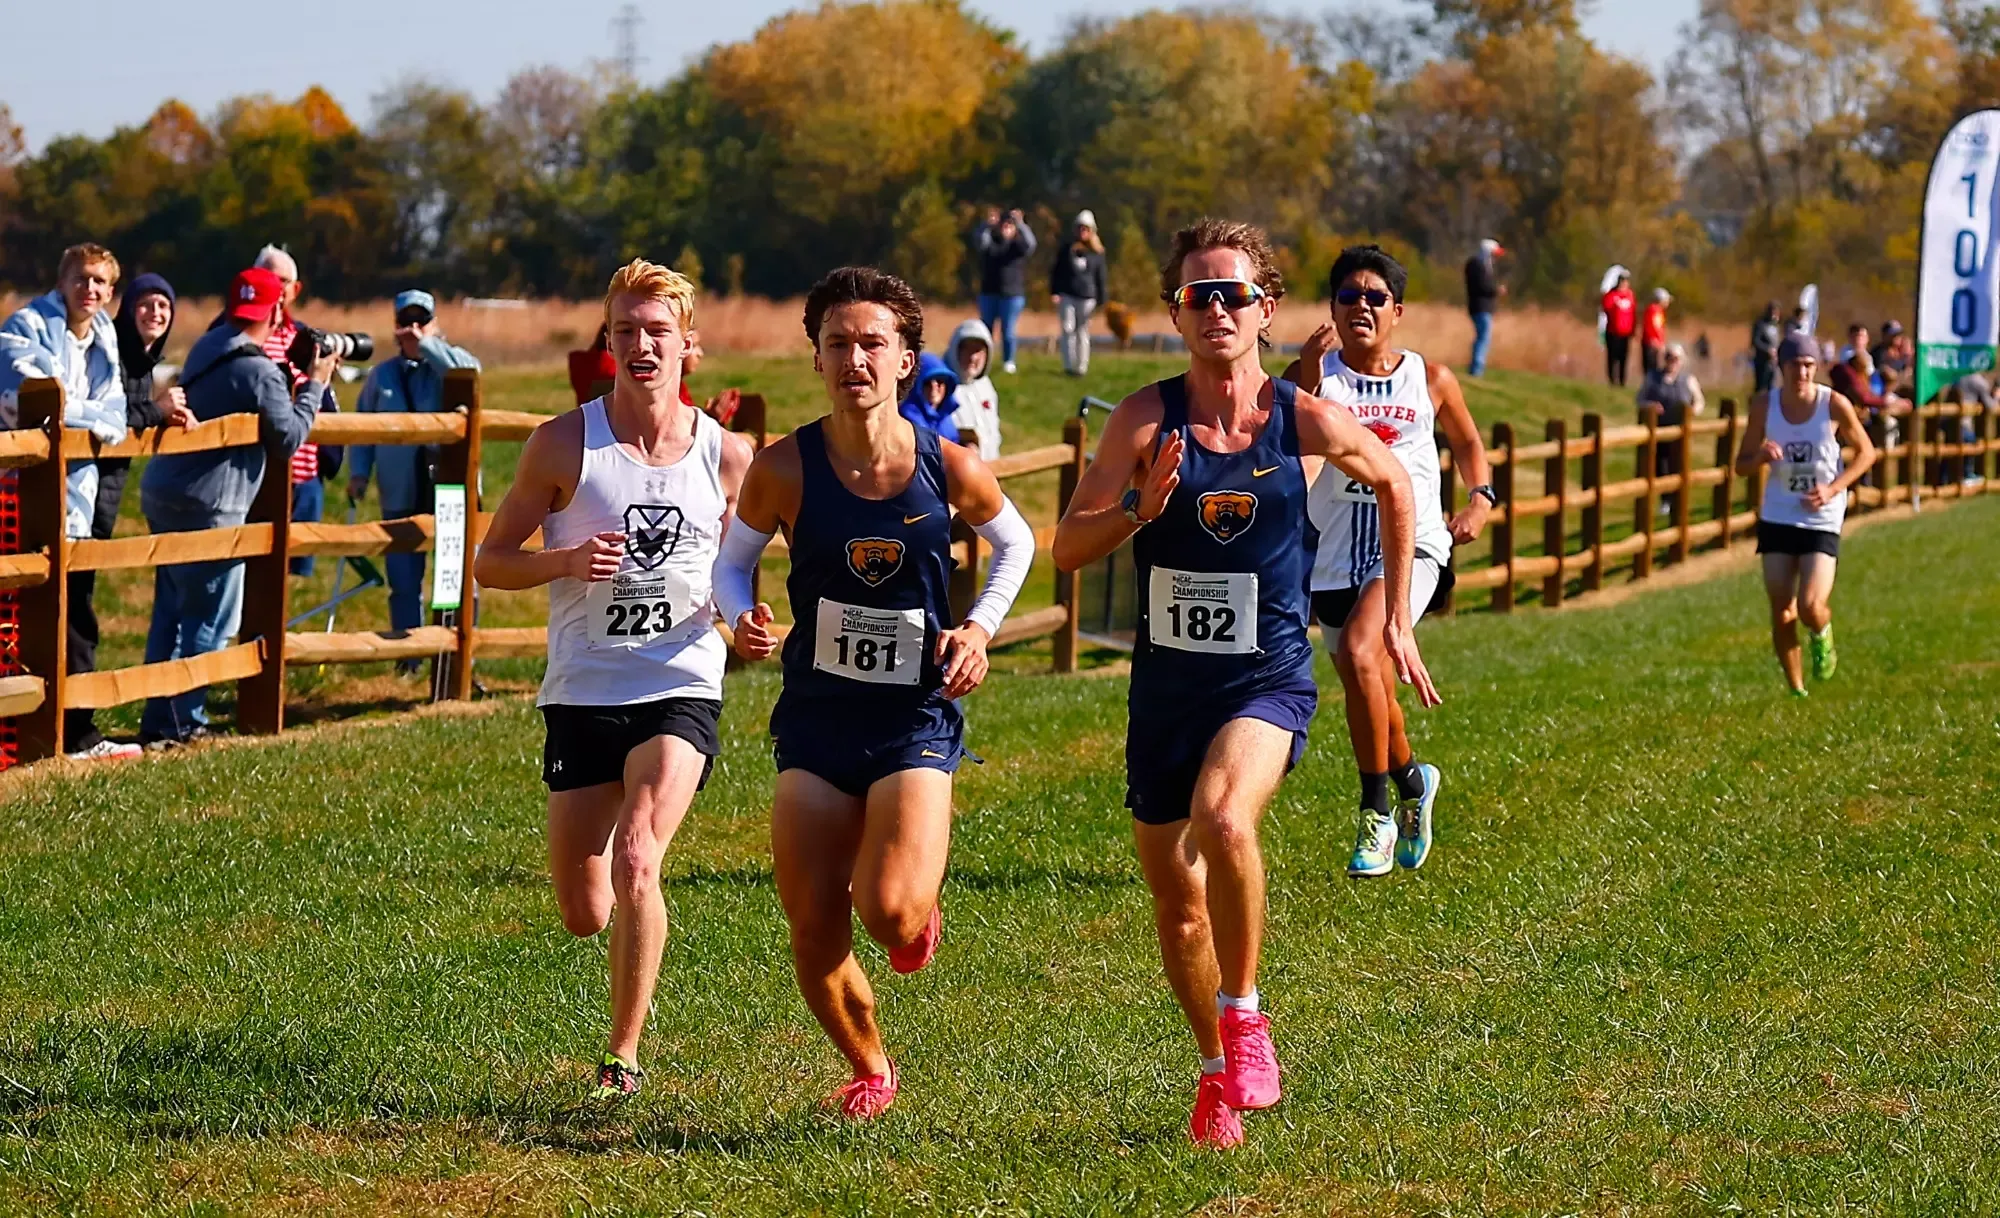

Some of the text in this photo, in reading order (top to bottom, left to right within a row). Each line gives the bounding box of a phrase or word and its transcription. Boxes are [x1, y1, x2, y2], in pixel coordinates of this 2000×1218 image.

[613, 586, 666, 597] CHAMPIONSHIP
[1173, 585, 1229, 599] CHAMPIONSHIP
[606, 602, 672, 636] 223
[841, 618, 898, 633] CHAMPIONSHIP
[1167, 604, 1236, 642] 182
[833, 635, 898, 672] 181
